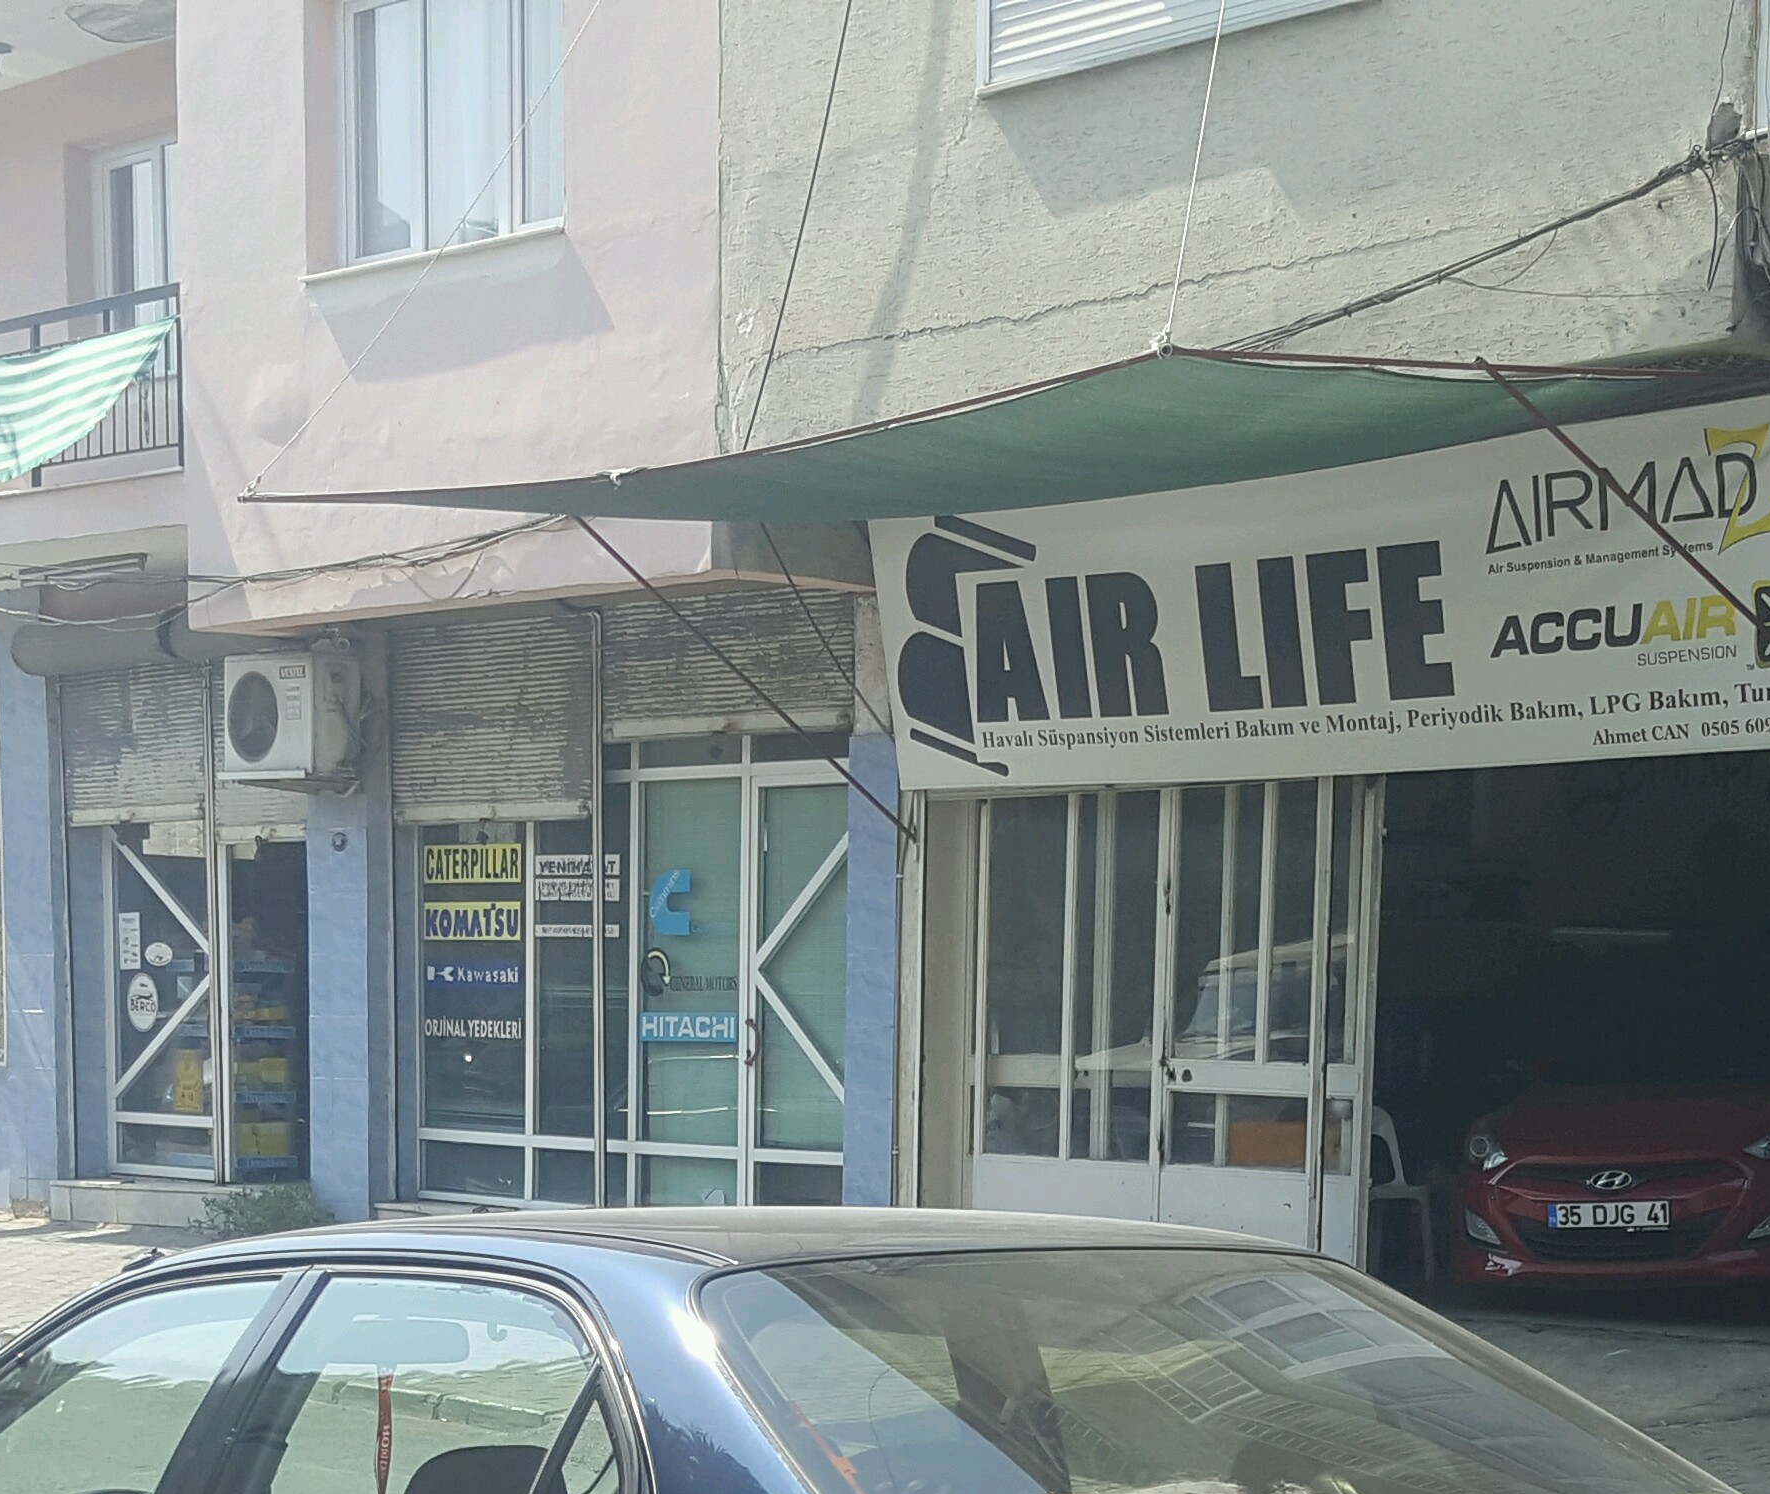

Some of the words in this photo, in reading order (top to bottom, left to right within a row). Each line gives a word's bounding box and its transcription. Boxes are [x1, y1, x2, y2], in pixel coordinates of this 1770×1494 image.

[1487, 562, 1505, 575] Air
[1506, 556, 1571, 574] Suspension
[1574, 555, 1583, 567] &
[1585, 545, 1660, 565] Management
[975, 571, 1170, 724] AIR
[1194, 540, 1456, 714] LIFE
[1489, 595, 1738, 659] ACCUAIR
[1636, 645, 1738, 667] SUSPENSION
[981, 729, 1034, 749] Havalı
[1037, 726, 1140, 752] Süspansiyon
[1143, 720, 1230, 745] Sistemleri
[1235, 717, 1295, 740] Bakım
[1300, 720, 1322, 735] ve
[1325, 711, 1402, 736] Montaj,
[1406, 707, 1504, 731] Periyodik
[1510, 701, 1585, 723] Bakım,
[1589, 692, 1641, 716] LPG
[1647, 687, 1729, 711] Bakım,
[1592, 727, 1649, 747] Ahmet
[1651, 723, 1690, 742] CAN
[1700, 719, 1740, 738] 0505
[426, 848, 519, 880] CATERPILLAR
[425, 908, 519, 938] KOMATSU
[457, 966, 519, 983] Kawasaki
[424, 1015, 466, 1037] ORJİNAL
[467, 1017, 522, 1039] YEDEKLERİ
[641, 1016, 736, 1039] HITACHI
[1558, 1204, 1582, 1225] 35
[1592, 1203, 1636, 1225] DJG
[1647, 1203, 1669, 1224] 41
